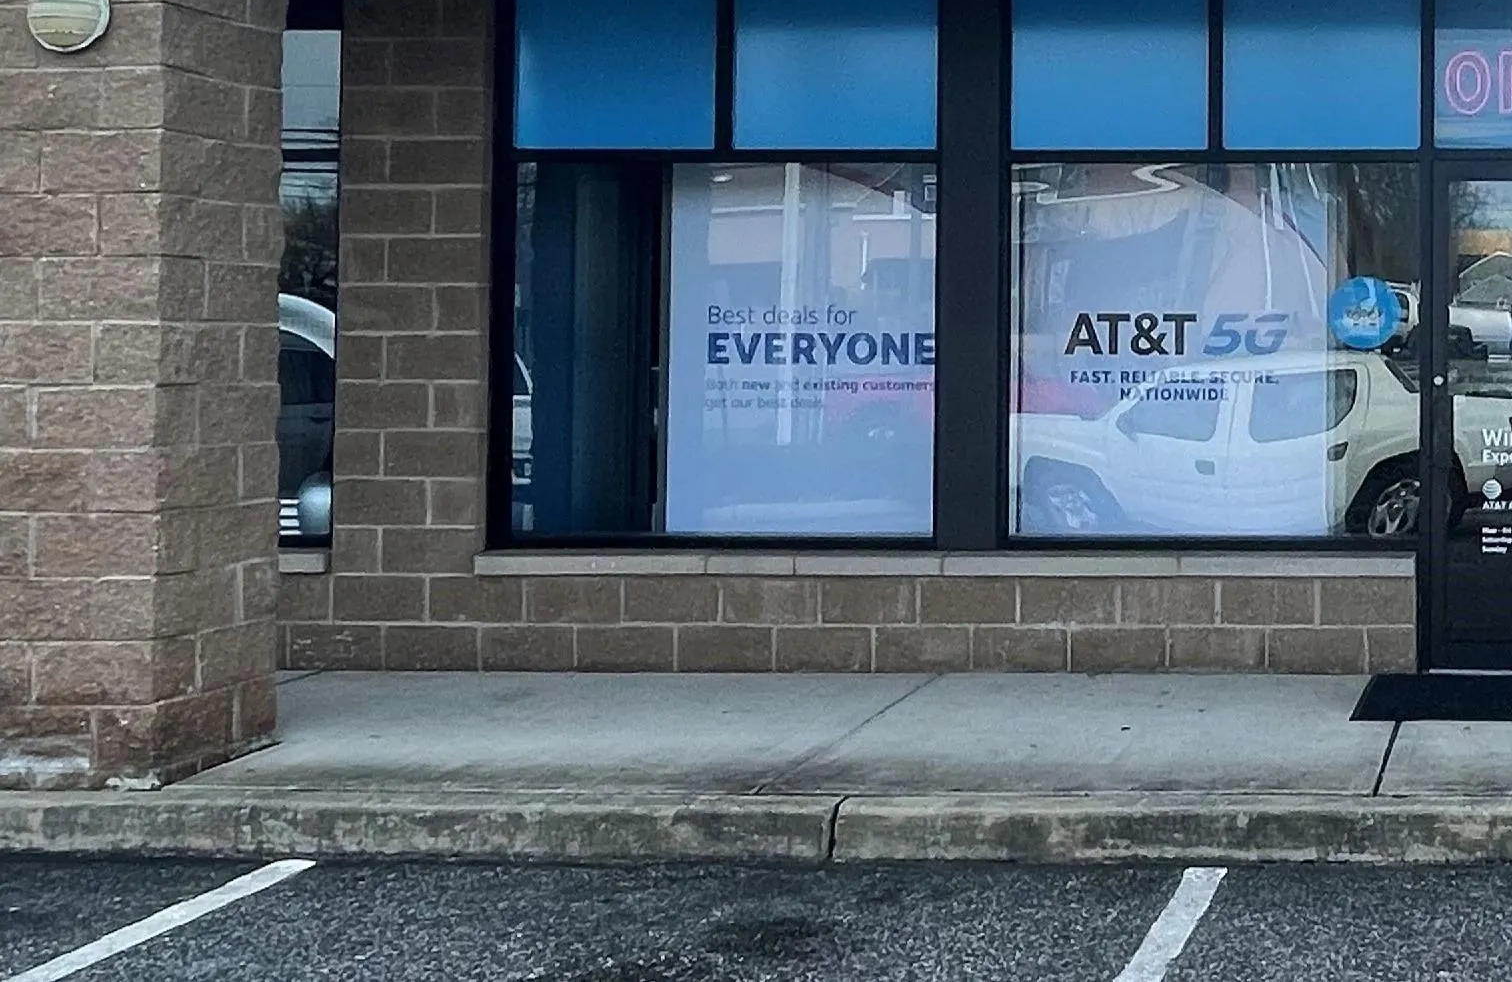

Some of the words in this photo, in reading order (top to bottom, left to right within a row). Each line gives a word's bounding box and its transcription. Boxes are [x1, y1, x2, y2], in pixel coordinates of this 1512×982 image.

[707, 304, 755, 326] Best
[762, 304, 819, 326] deals
[826, 303, 859, 326] for
[1064, 312, 1198, 356] AT&T
[1202, 313, 1290, 356] 5G
[707, 331, 936, 366] EVERYONE
[742, 380, 771, 391] new
[802, 377, 857, 394] existing
[1069, 370, 1116, 384] FAST.
